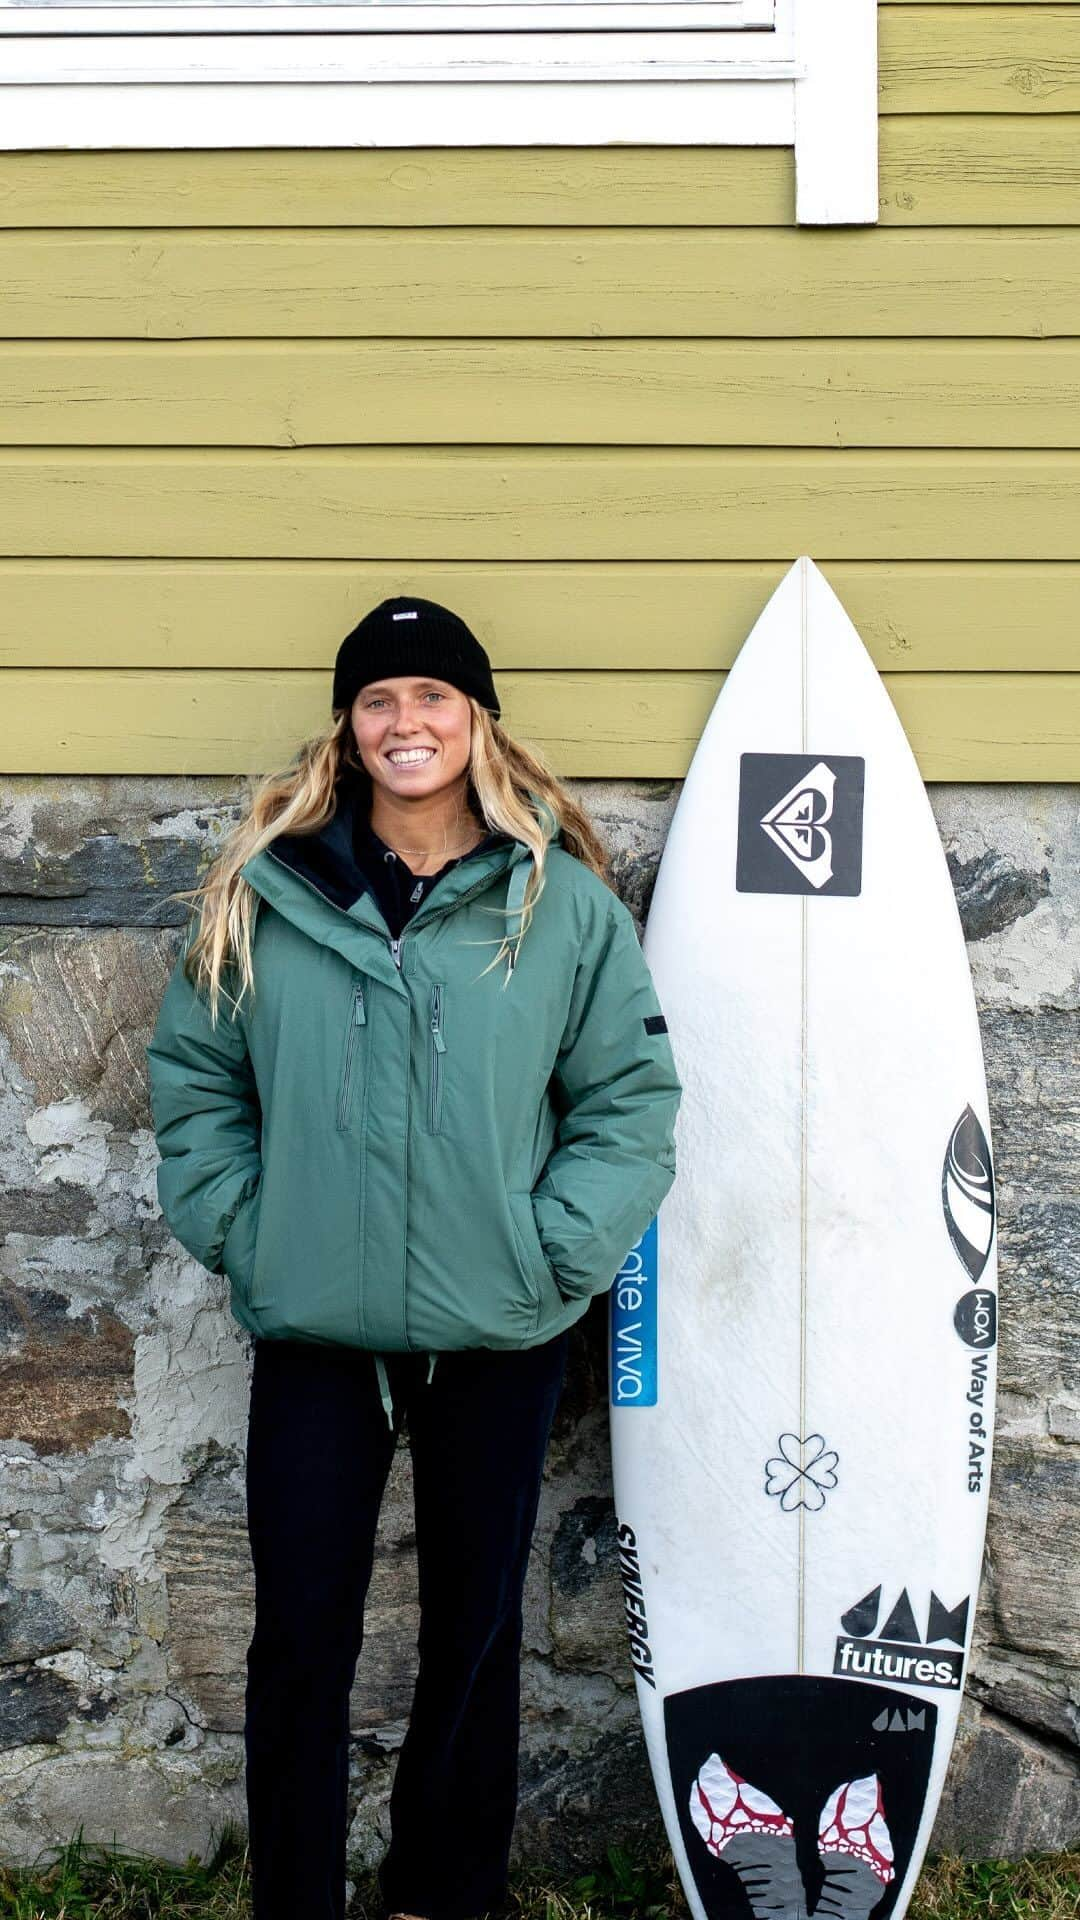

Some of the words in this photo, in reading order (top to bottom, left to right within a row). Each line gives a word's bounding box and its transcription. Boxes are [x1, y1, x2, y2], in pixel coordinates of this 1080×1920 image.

[617, 1234, 648, 1310] ate
[974, 1294, 990, 1343] WOA
[966, 1354, 988, 1408] Way
[969, 1412, 987, 1438] of
[967, 1441, 985, 1493] Arts
[617, 1524, 656, 1690] SYNERGY
[840, 1643, 959, 1685] futures.
